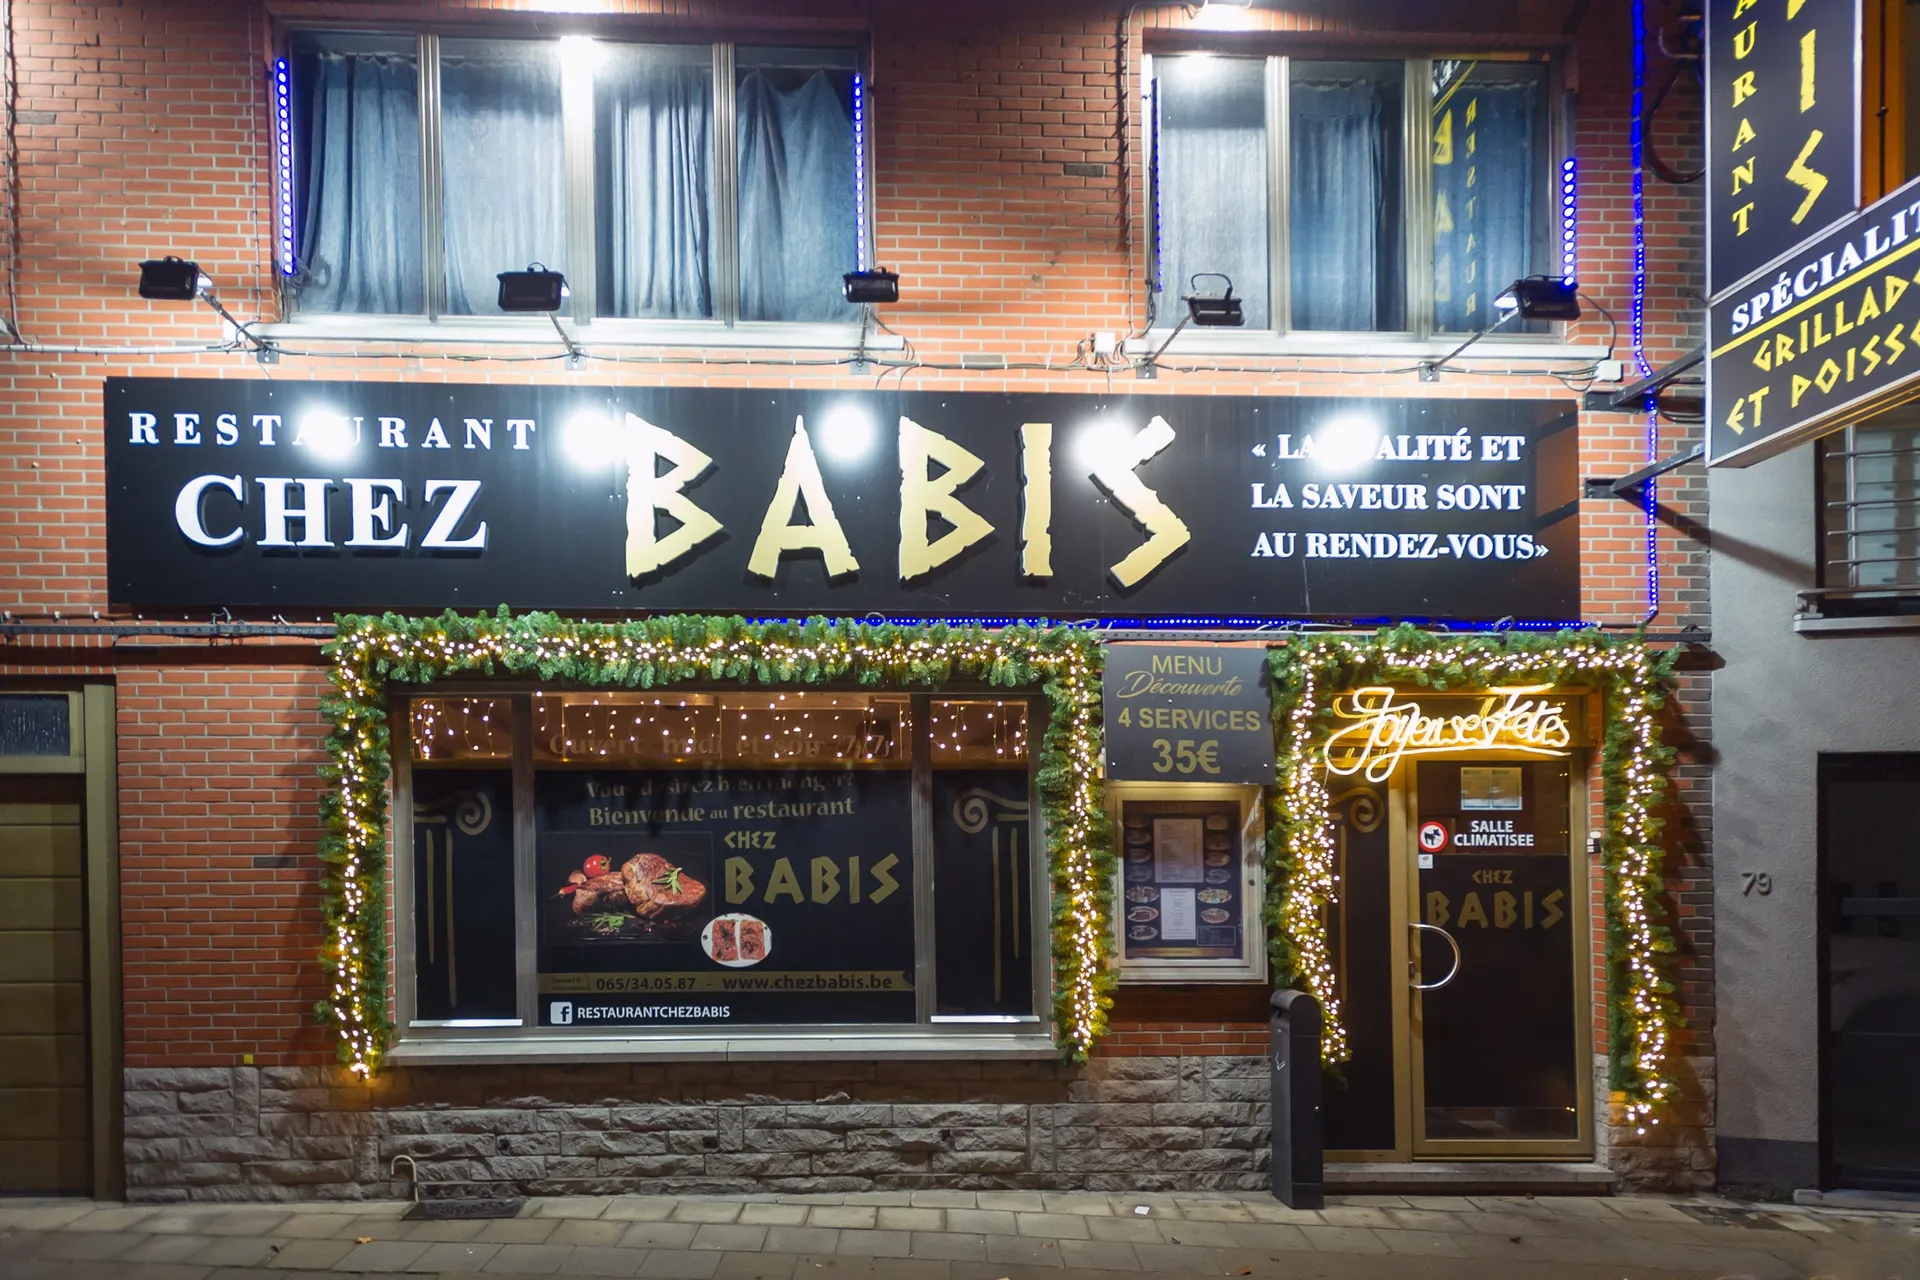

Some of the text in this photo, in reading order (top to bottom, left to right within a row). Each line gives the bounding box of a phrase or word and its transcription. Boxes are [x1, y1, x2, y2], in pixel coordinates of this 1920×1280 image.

[1753, 271, 1920, 372] GRILLAD
[1726, 387, 1770, 436] ET
[1278, 433, 1317, 460] LA
[1481, 436, 1526, 462] ET
[625, 412, 1191, 587] BABIS
[1251, 484, 1526, 511] LA SAVEUR SONT
[175, 474, 488, 549] CHEZ
[1251, 533, 1297, 558] AU
[1151, 655, 1223, 676] MENU
[1117, 670, 1244, 698] Découverte
[1118, 707, 1262, 731] 4 SERVICES
[1152, 739, 1221, 774] 35€
[588, 798, 856, 827] Bienvenue au restaurant
[724, 831, 776, 849] CHEZ
[1453, 834, 1535, 847] CLIMATISEE
[1471, 821, 1514, 833] SALLE
[724, 853, 900, 905] BABIS
[1472, 869, 1513, 884] CHEZ
[1741, 872, 1772, 897] 79
[1426, 889, 1565, 930] BABIS
[596, 977, 696, 991] 065/34.05.87
[722, 974, 893, 990] www.chezbabis.be
[577, 1006, 731, 1020] RESTAURANTCHEZBABIS
